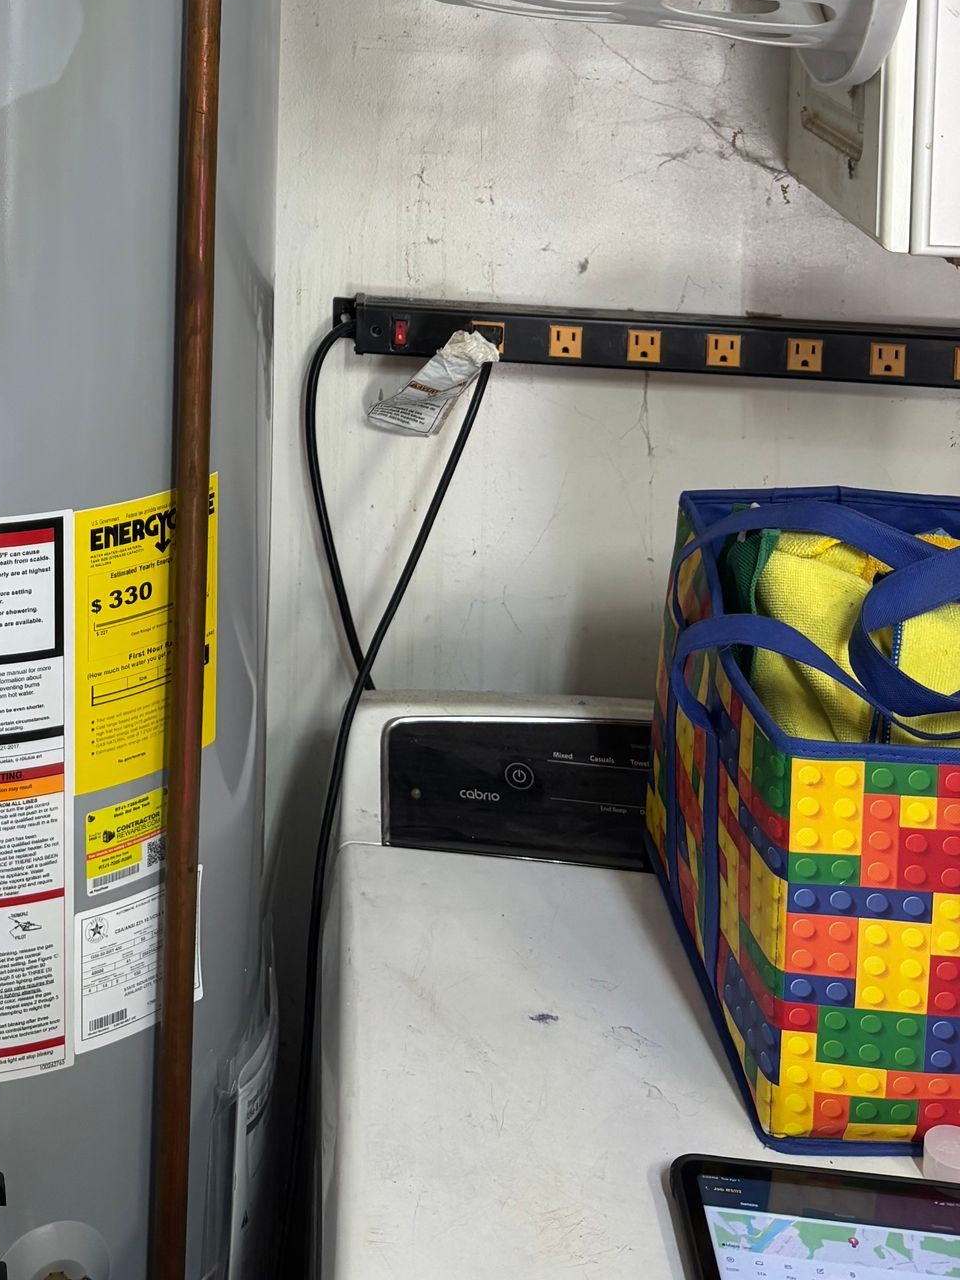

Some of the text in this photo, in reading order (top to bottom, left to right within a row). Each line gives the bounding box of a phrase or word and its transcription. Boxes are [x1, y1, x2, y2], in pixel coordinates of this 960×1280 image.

[110, 567, 137, 578] Estimated
[139, 563, 155, 572] Yearly
[91, 582, 152, 613] $ 330
[128, 645, 163, 660] First Hour
[104, 666, 119, 675] much
[132, 658, 146, 668] water
[553, 752, 573, 760] Mixed
[590, 755, 615, 764] Casuals
[460, 788, 500, 802] cabrio
[116, 812, 160, 832] CONTRACTOR
